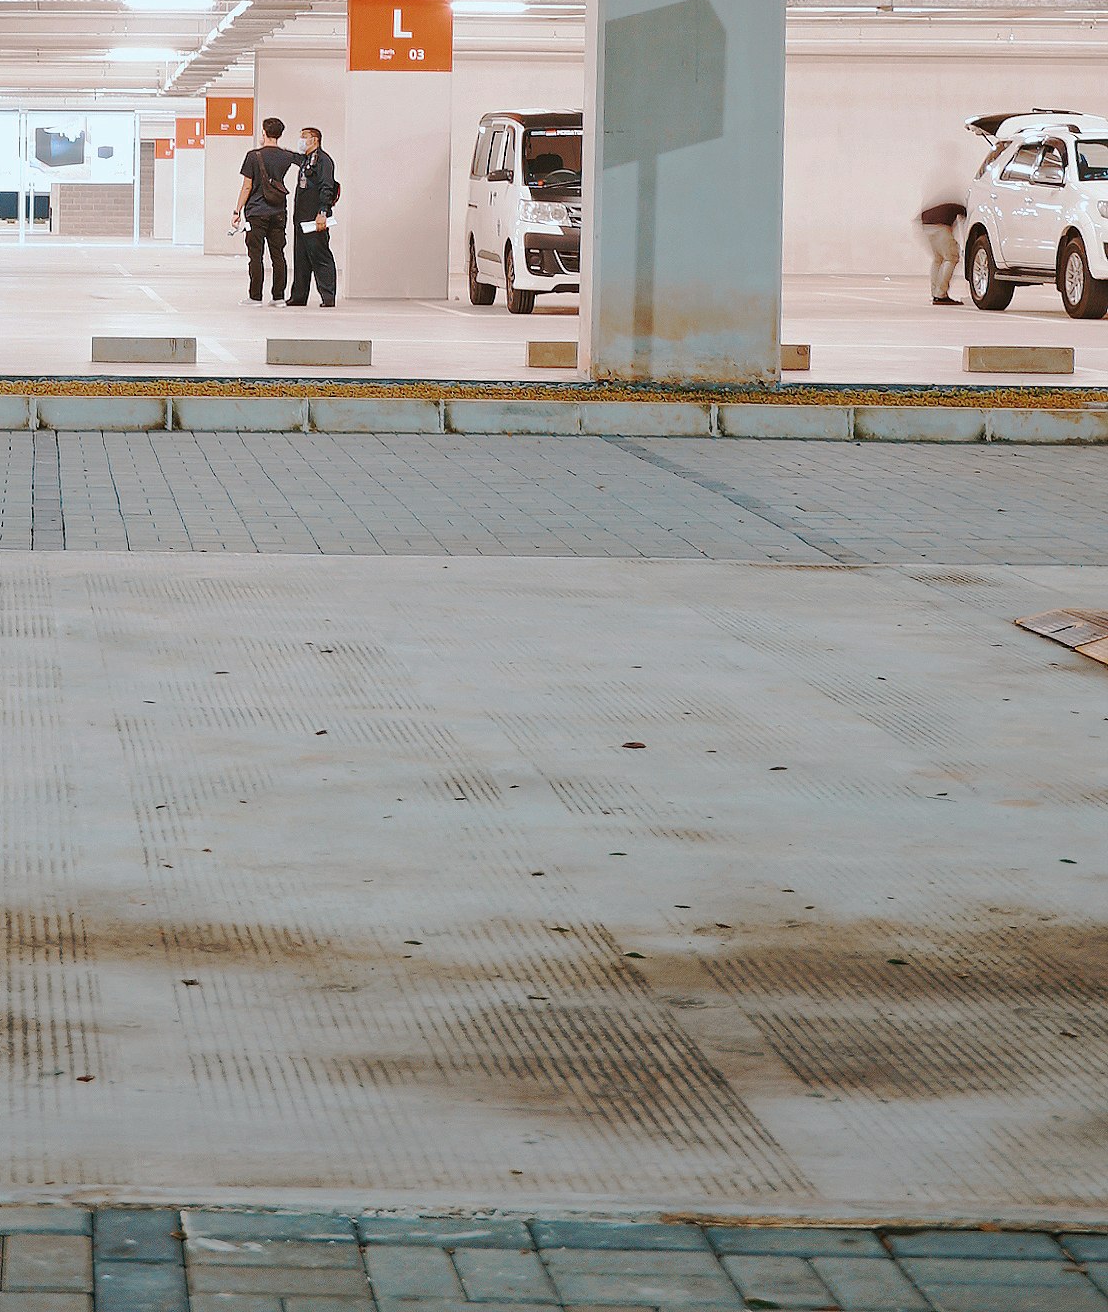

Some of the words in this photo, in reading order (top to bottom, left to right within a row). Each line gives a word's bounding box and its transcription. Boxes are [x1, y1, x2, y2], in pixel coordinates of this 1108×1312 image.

[393, 8, 413, 39] L
[409, 48, 425, 61] 03
[227, 102, 238, 119] J
